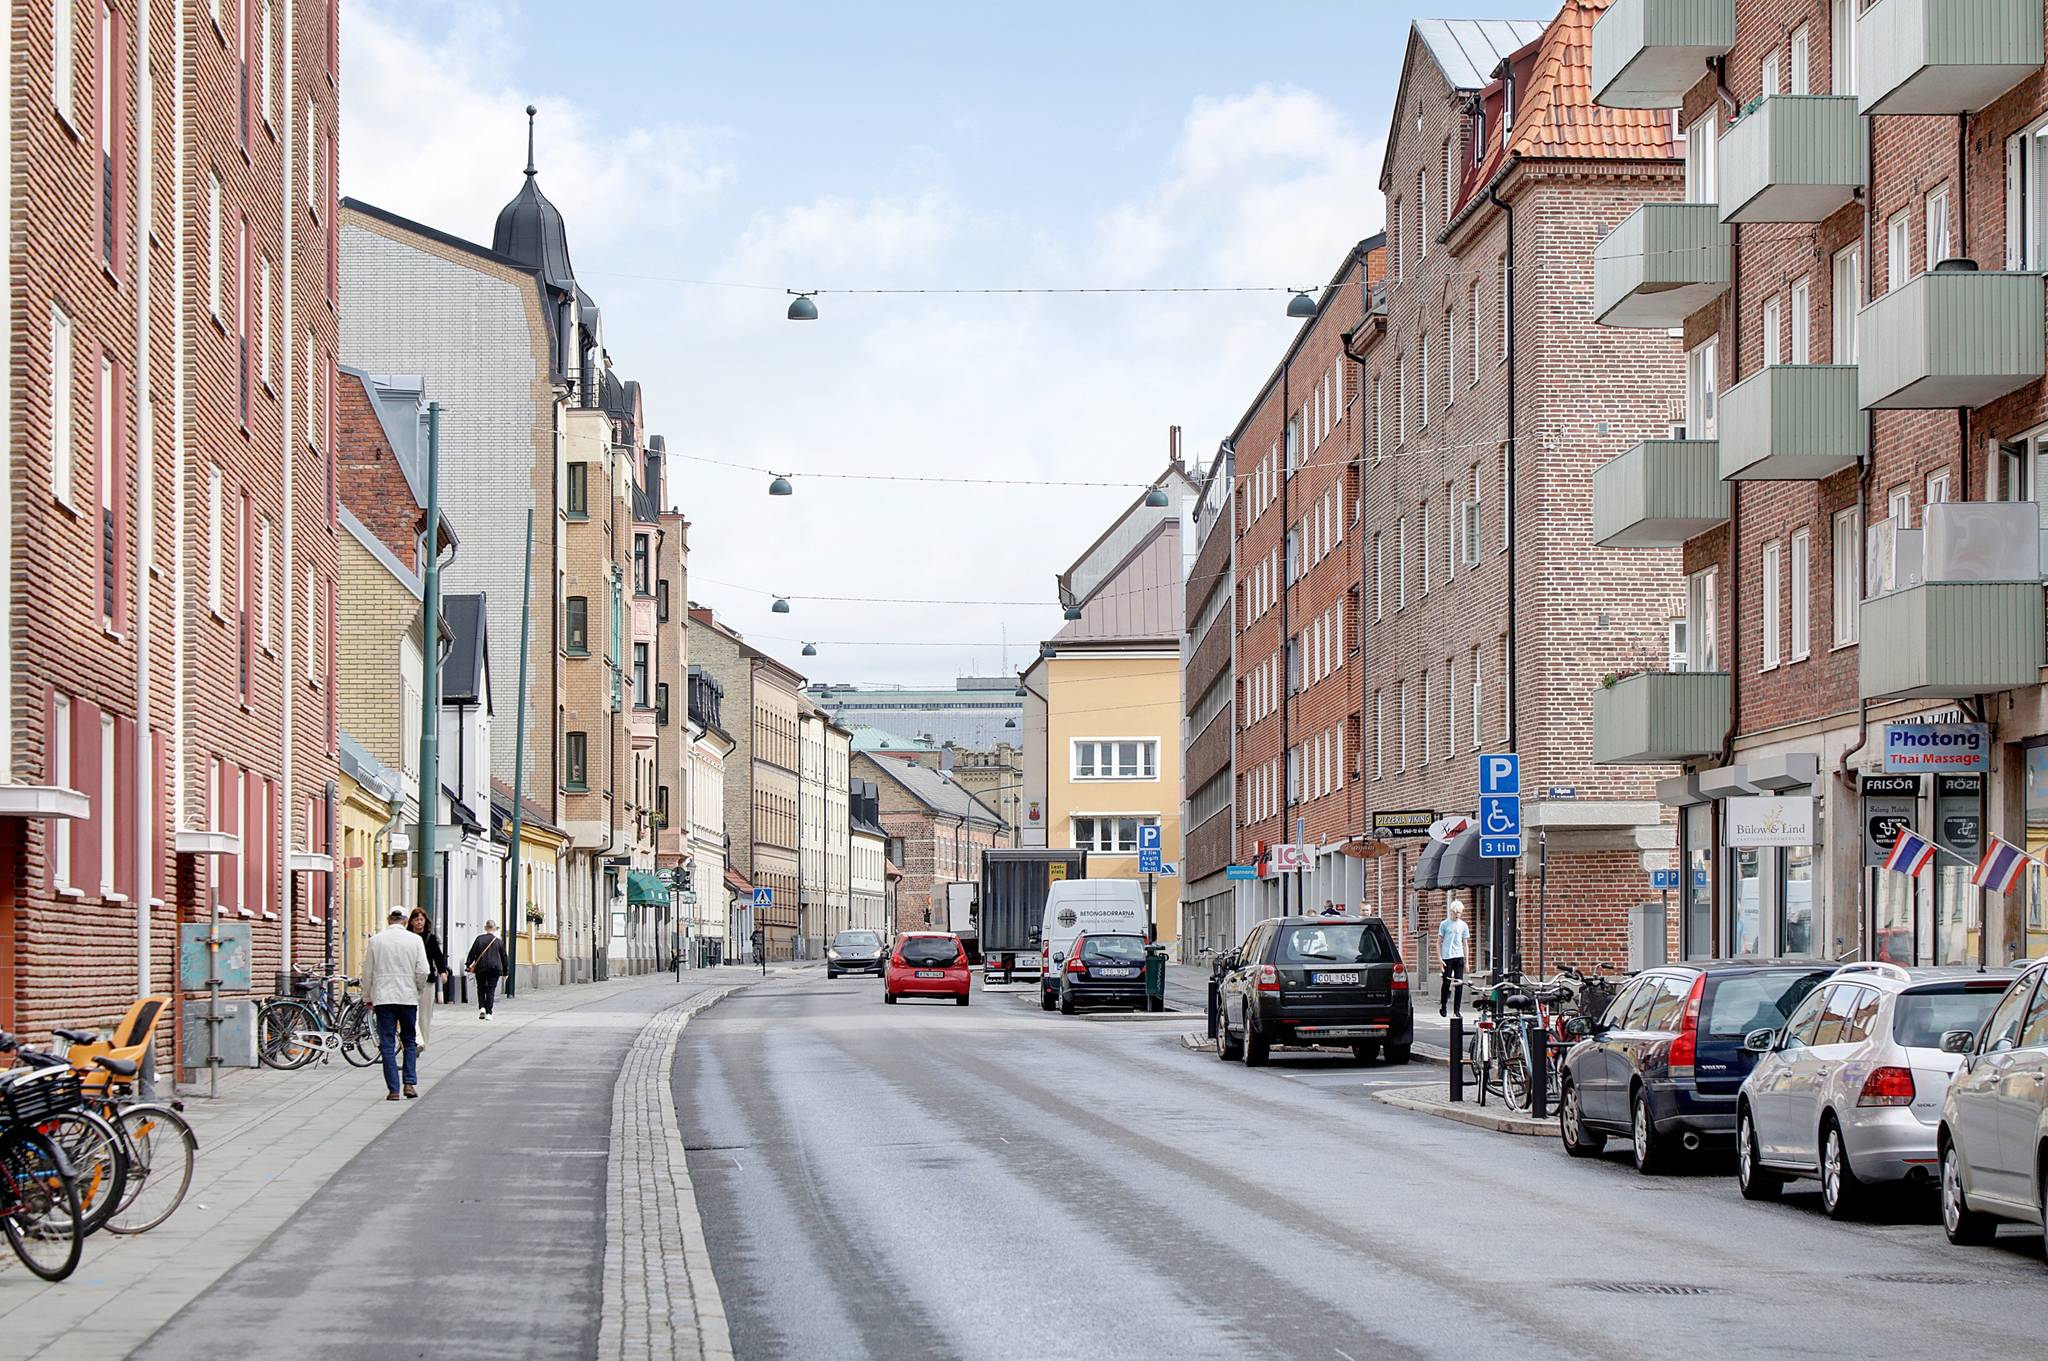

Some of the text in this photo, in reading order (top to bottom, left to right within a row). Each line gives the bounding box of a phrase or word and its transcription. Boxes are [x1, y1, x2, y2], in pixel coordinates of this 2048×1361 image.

[1890, 731, 1980, 750] Photong
[1890, 754, 1980, 766] Thai Massage
[1490, 758, 1512, 790] P
[1866, 778, 1913, 791] FRISÖR
[1377, 814, 1430, 825] PIZZERIA VIKING
[1736, 824, 1805, 834] Bülow & Lind
[1144, 828, 1157, 847] P
[1485, 842, 1516, 852] 3 tim
[1657, 873, 1664, 881] P
[1317, 973, 1358, 982] COL 055
